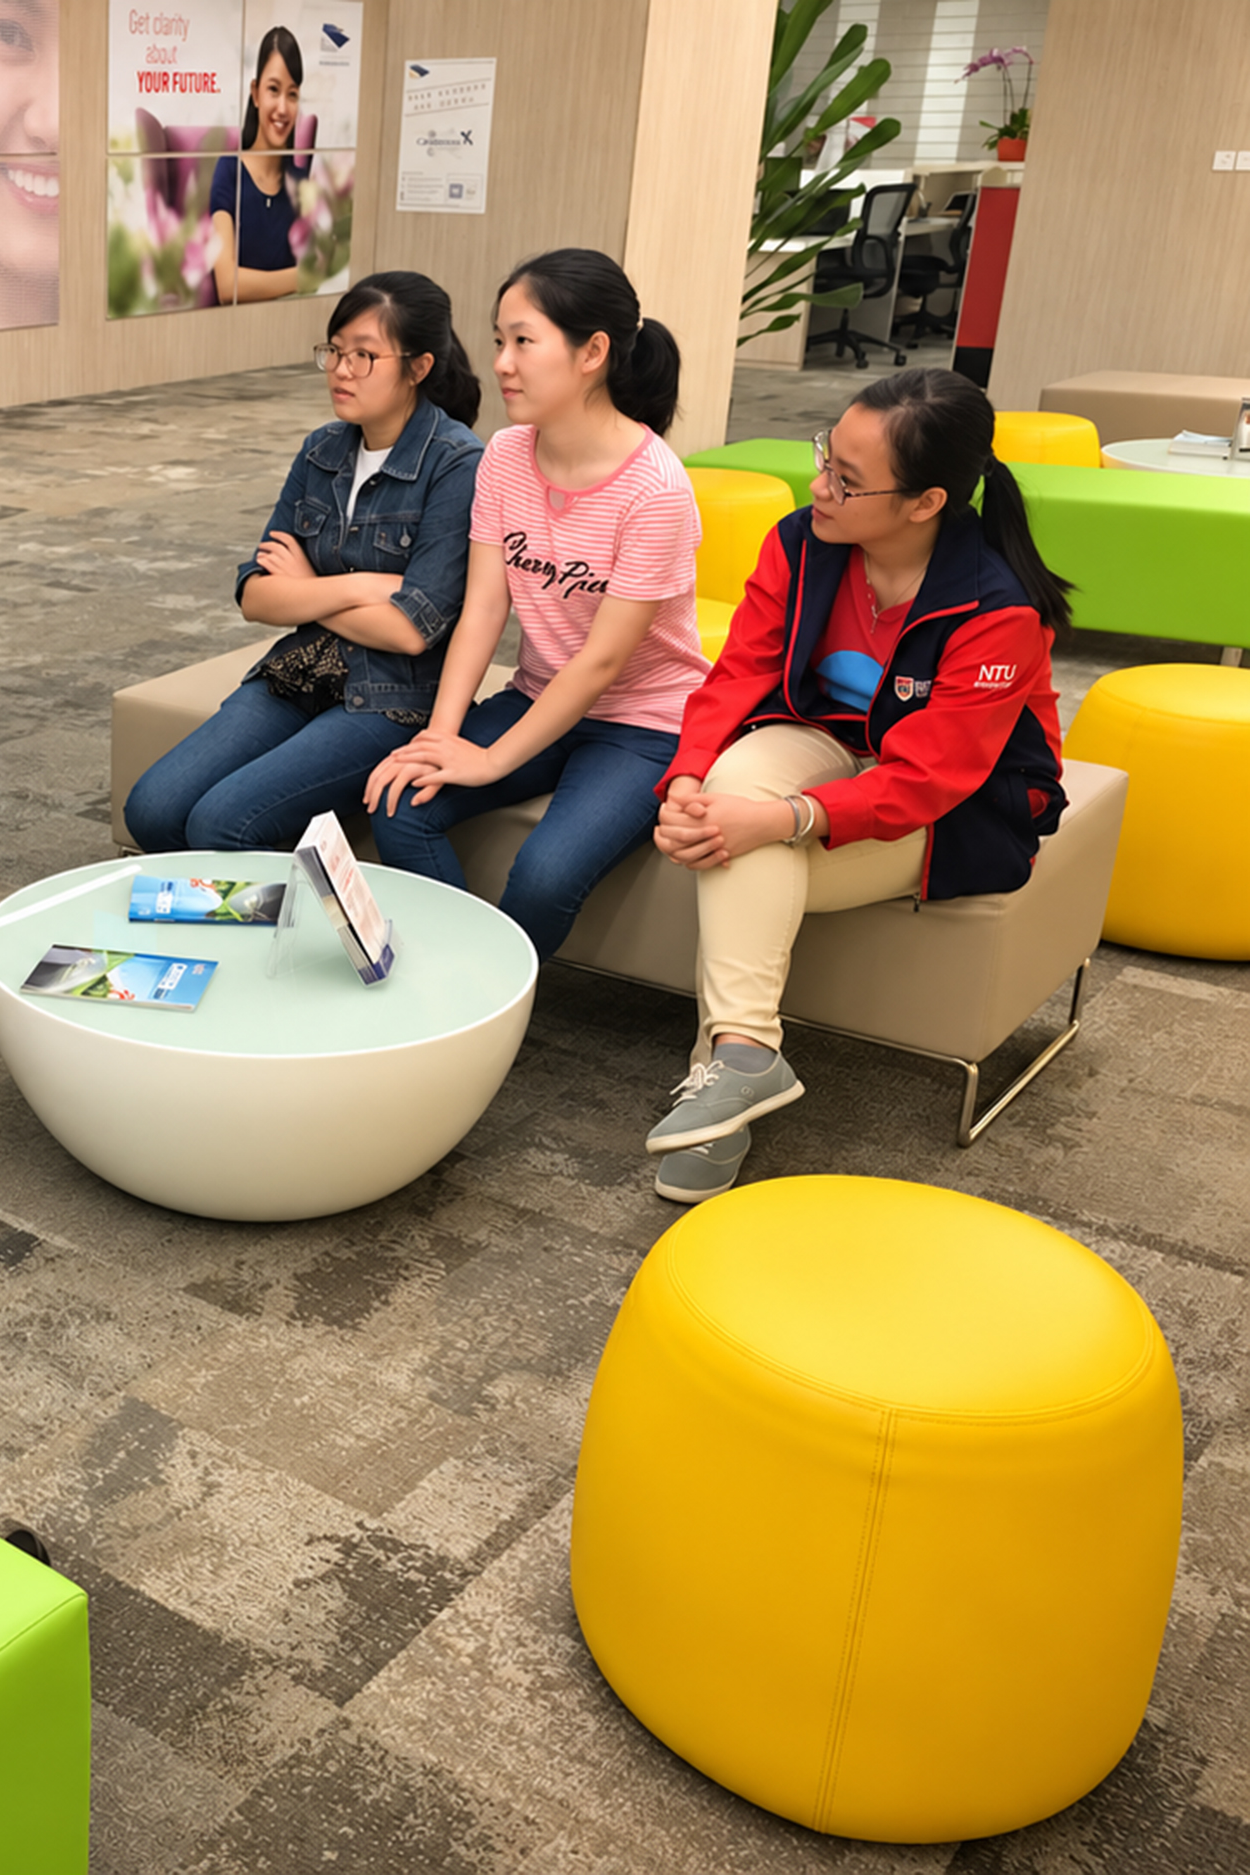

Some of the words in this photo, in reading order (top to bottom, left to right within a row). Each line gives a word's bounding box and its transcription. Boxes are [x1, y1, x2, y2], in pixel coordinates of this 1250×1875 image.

[129, 8, 150, 35] Get
[152, 11, 190, 42] clarity
[145, 43, 178, 65] about
[136, 71, 170, 94] YOUR
[172, 71, 221, 94] FUTURE.
[978, 664, 1018, 682] NTU
